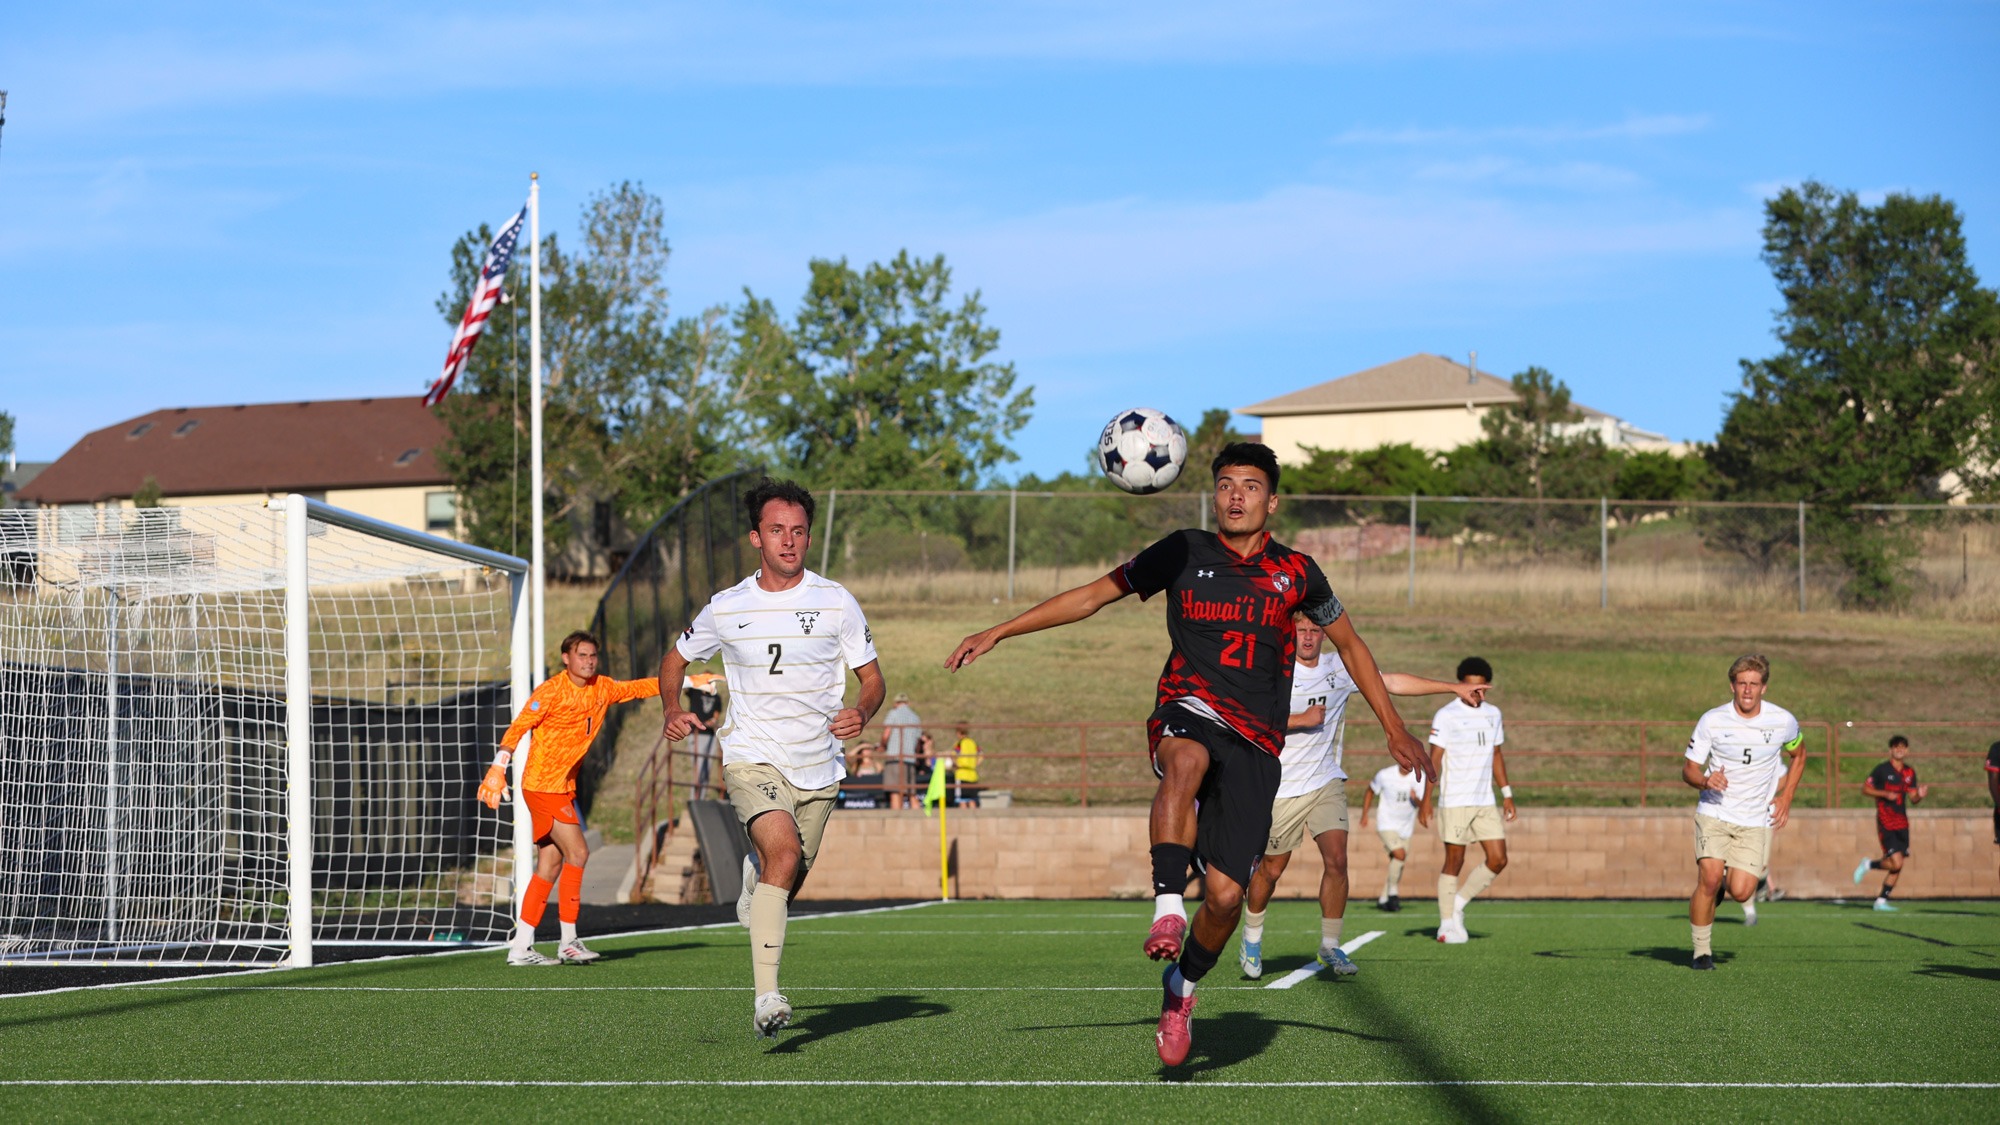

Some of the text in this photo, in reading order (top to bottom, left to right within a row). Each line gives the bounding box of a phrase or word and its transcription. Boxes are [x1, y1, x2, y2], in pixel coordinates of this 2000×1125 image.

[768, 643, 783, 675] 2
[1220, 630, 1257, 670] 21
[586, 716, 592, 735] 1
[1477, 731, 1486, 746] 11
[1742, 748, 1752, 765] 5
